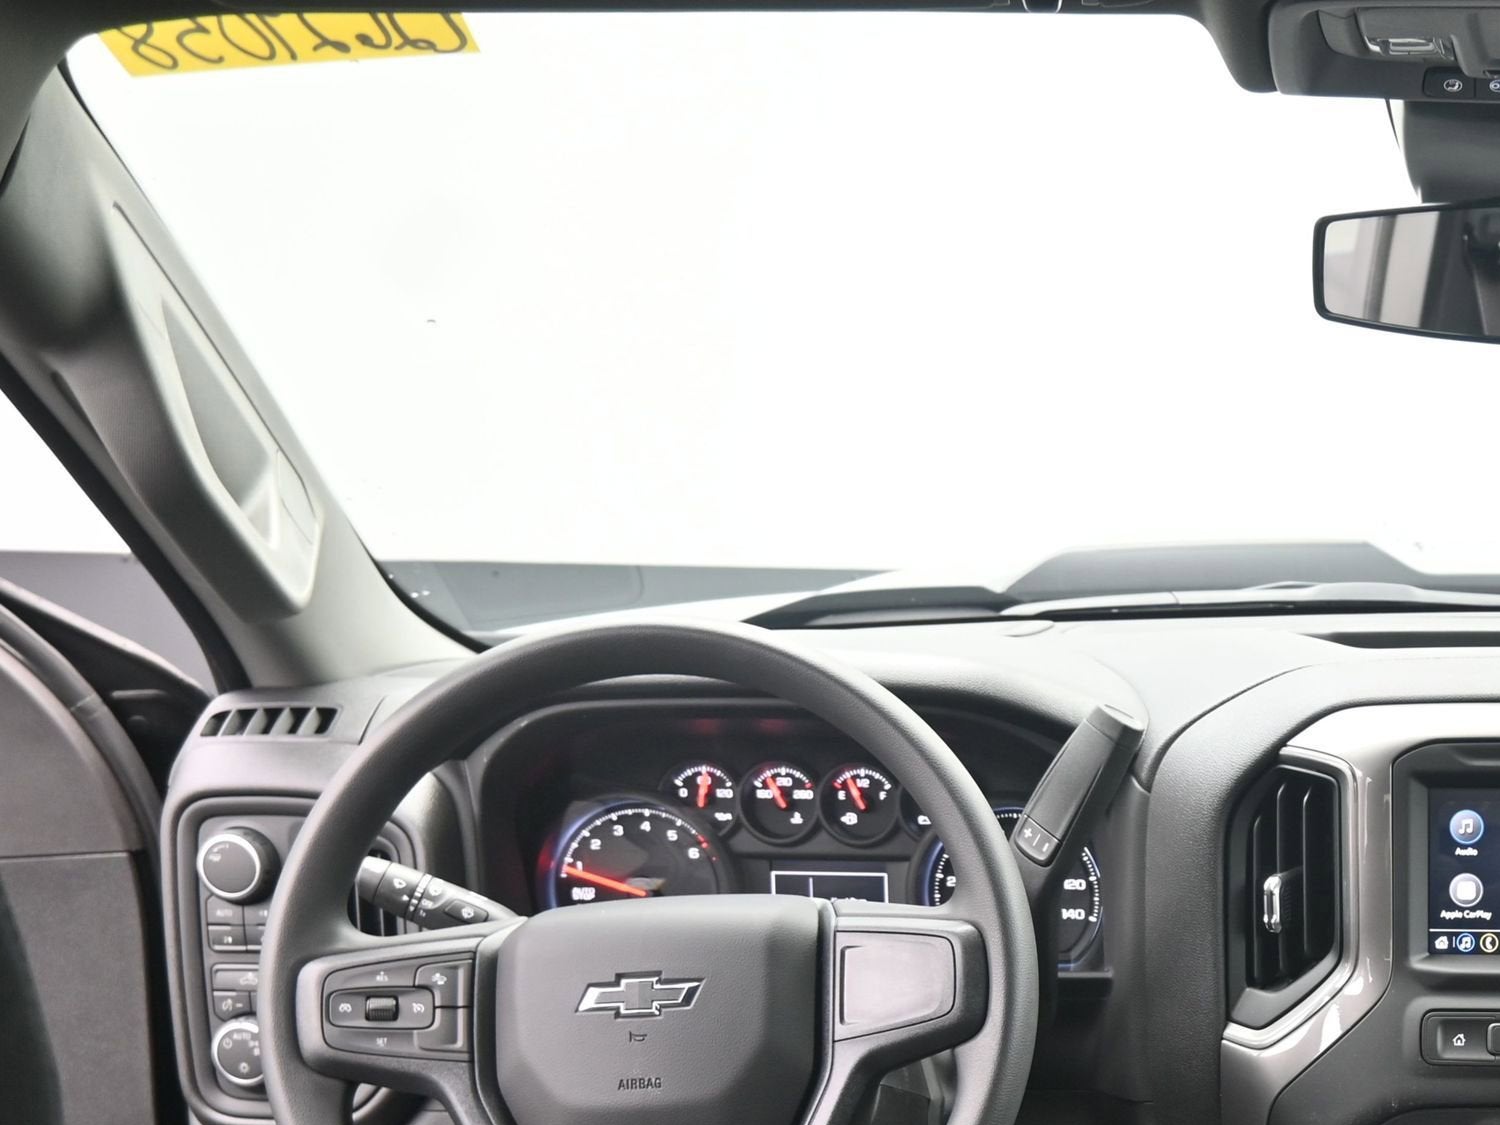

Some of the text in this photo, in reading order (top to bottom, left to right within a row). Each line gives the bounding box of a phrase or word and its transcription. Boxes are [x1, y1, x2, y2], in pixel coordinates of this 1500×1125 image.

[678, 787, 688, 798] 0
[612, 824, 624, 836] 3
[640, 820, 651, 832] 4
[666, 829, 678, 842] 5
[589, 838, 602, 850] 2
[687, 847, 700, 860] 6
[1455, 847, 1478, 857] Audio
[1061, 907, 1086, 920] 140
[1440, 909, 1492, 921] Apple CarPlay
[617, 1077, 662, 1091] AIRBAG
